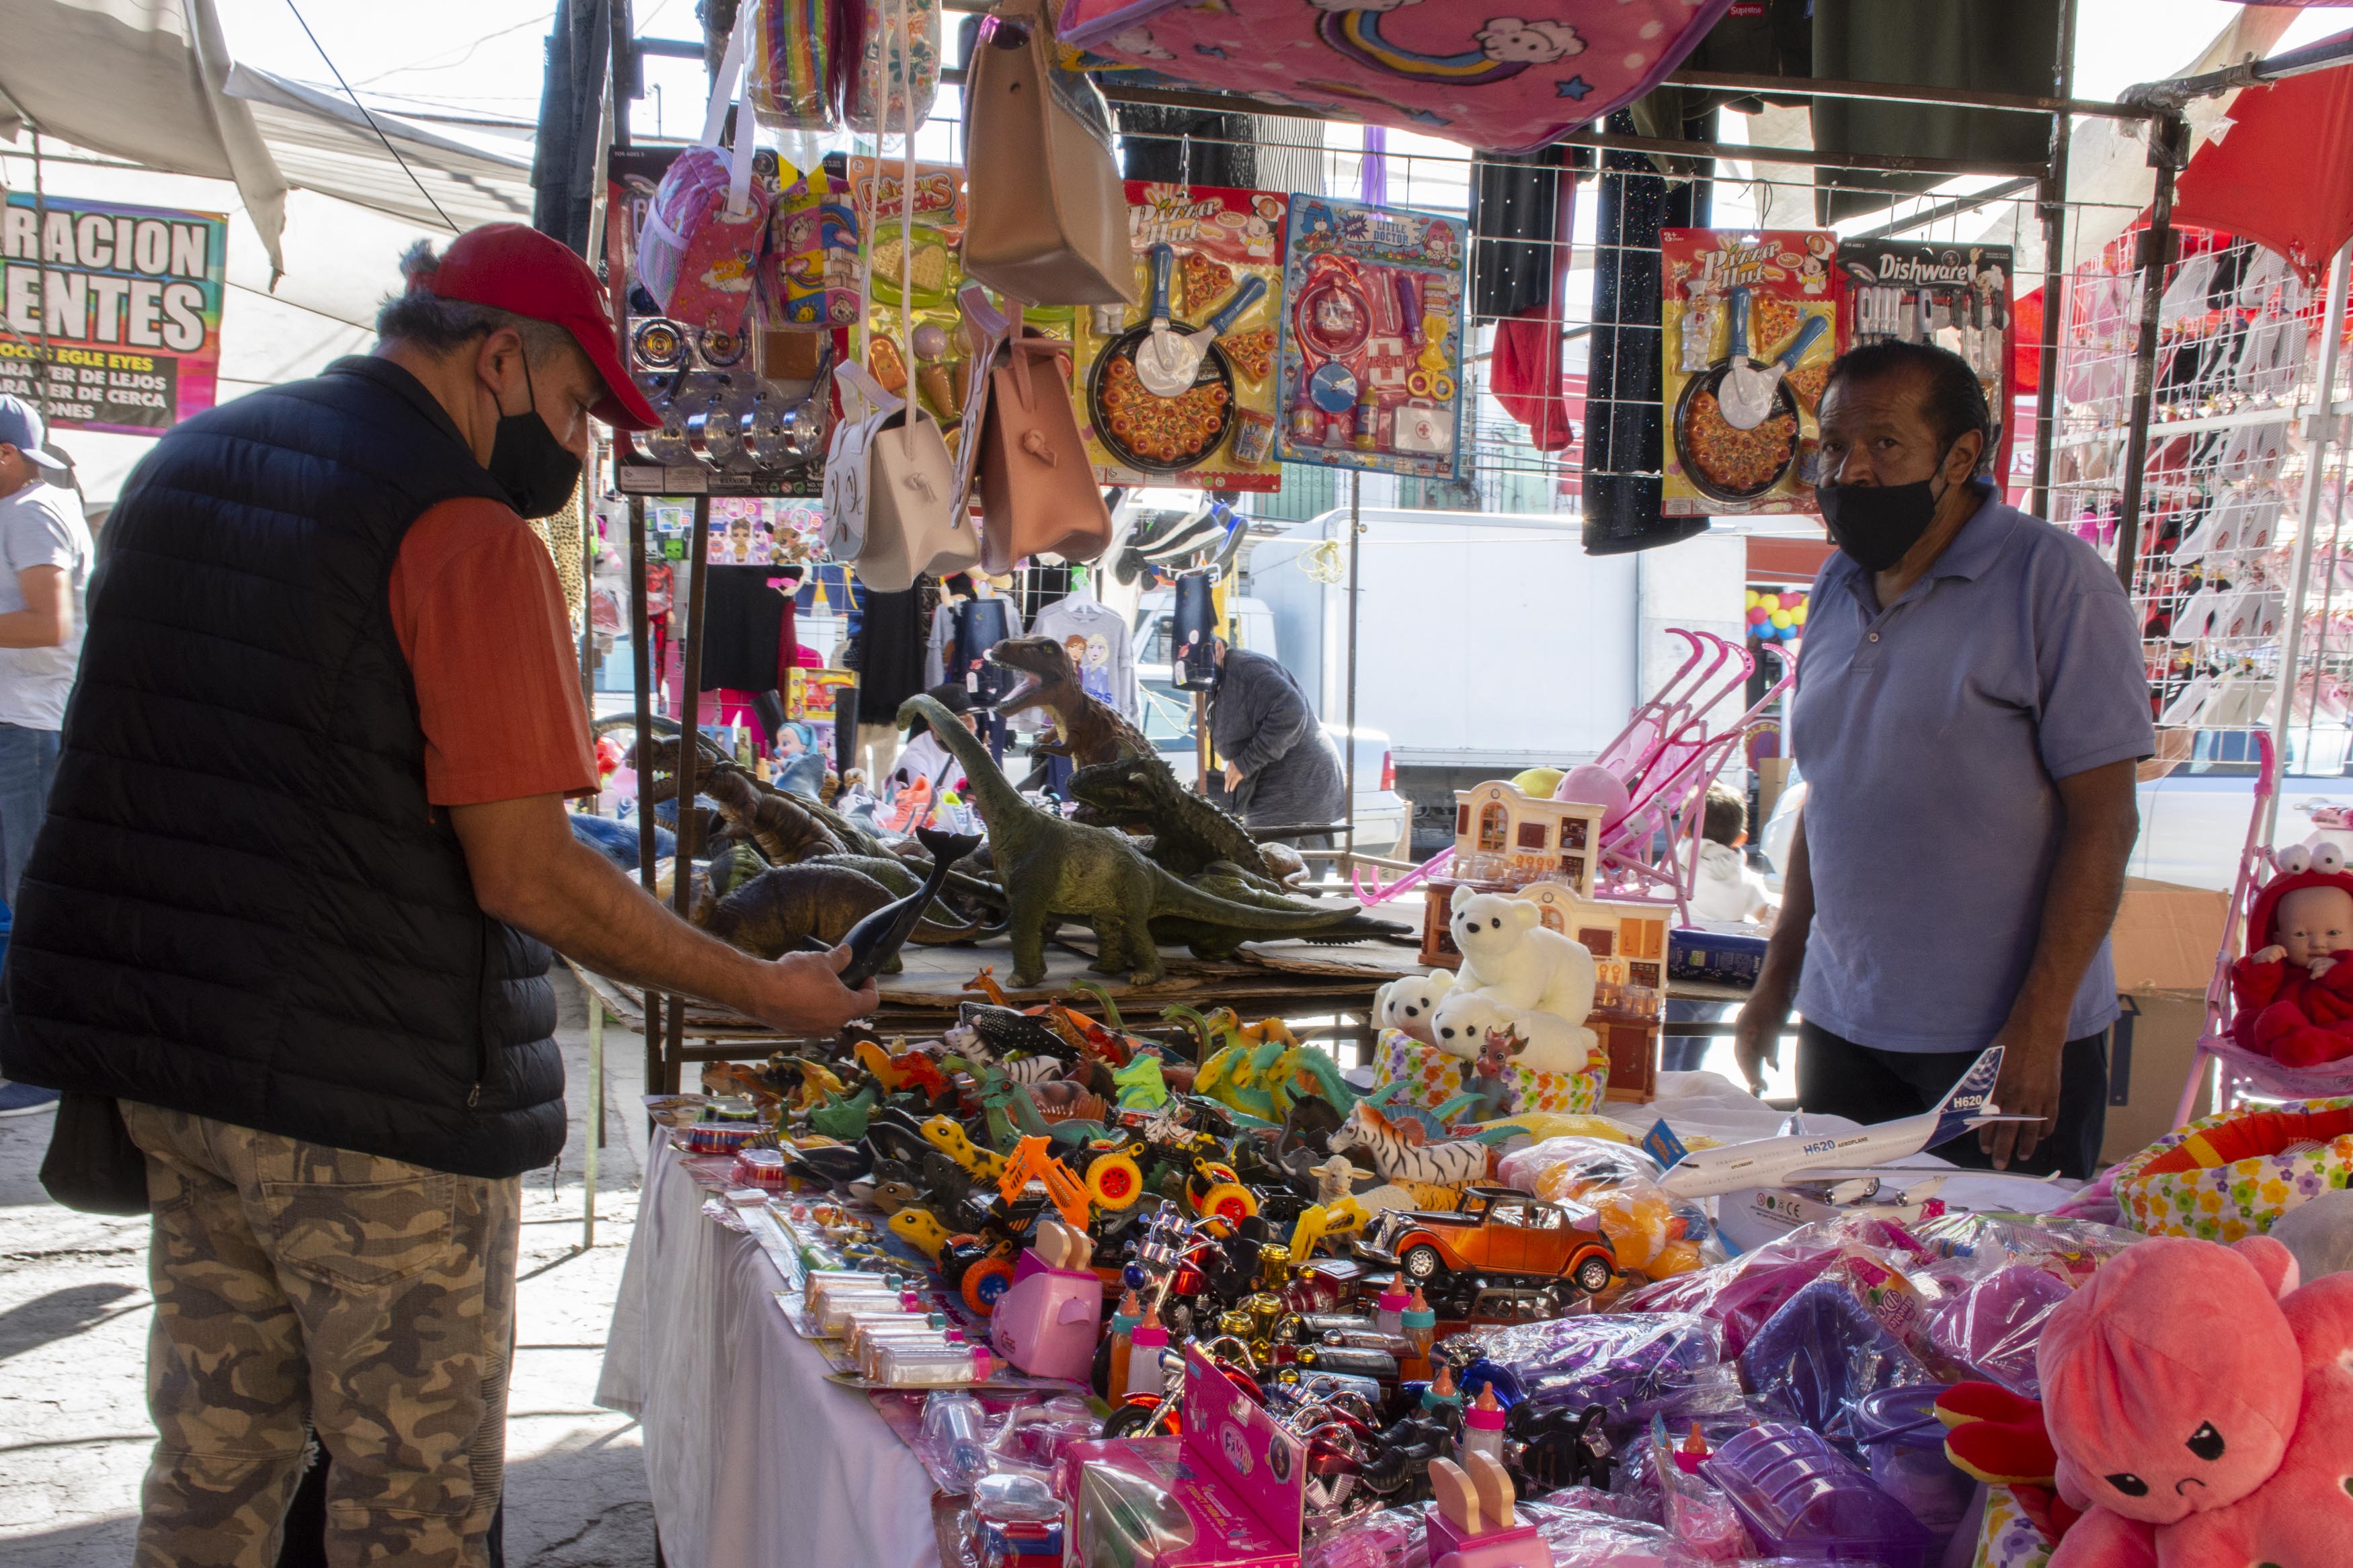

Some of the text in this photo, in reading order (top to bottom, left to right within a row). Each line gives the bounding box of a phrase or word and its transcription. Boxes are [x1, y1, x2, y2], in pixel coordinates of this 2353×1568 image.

[1128, 201, 1216, 236] Pizza
[1148, 218, 1200, 243] Hut
[1346, 221, 1363, 233] NEW
[1376, 220, 1406, 234] LITTLE
[1373, 232, 1409, 245] DOCTOR
[1702, 243, 1776, 281] Pizza
[1720, 261, 1765, 289] Hut
[1878, 253, 1969, 283] Dishware
[0, 261, 204, 352] ENTES
[56, 347, 105, 367] EGLE
[108, 354, 153, 372] EYES
[44, 365, 77, 382] ER
[79, 368, 106, 386] DE
[109, 371, 167, 392] LEJOS
[0, 378, 32, 396] RA
[77, 385, 104, 403] DE
[106, 388, 167, 409] CERCA
[1953, 1094, 1983, 1108] H620
[1803, 1137, 1868, 1156] H620 AEROPLANE
